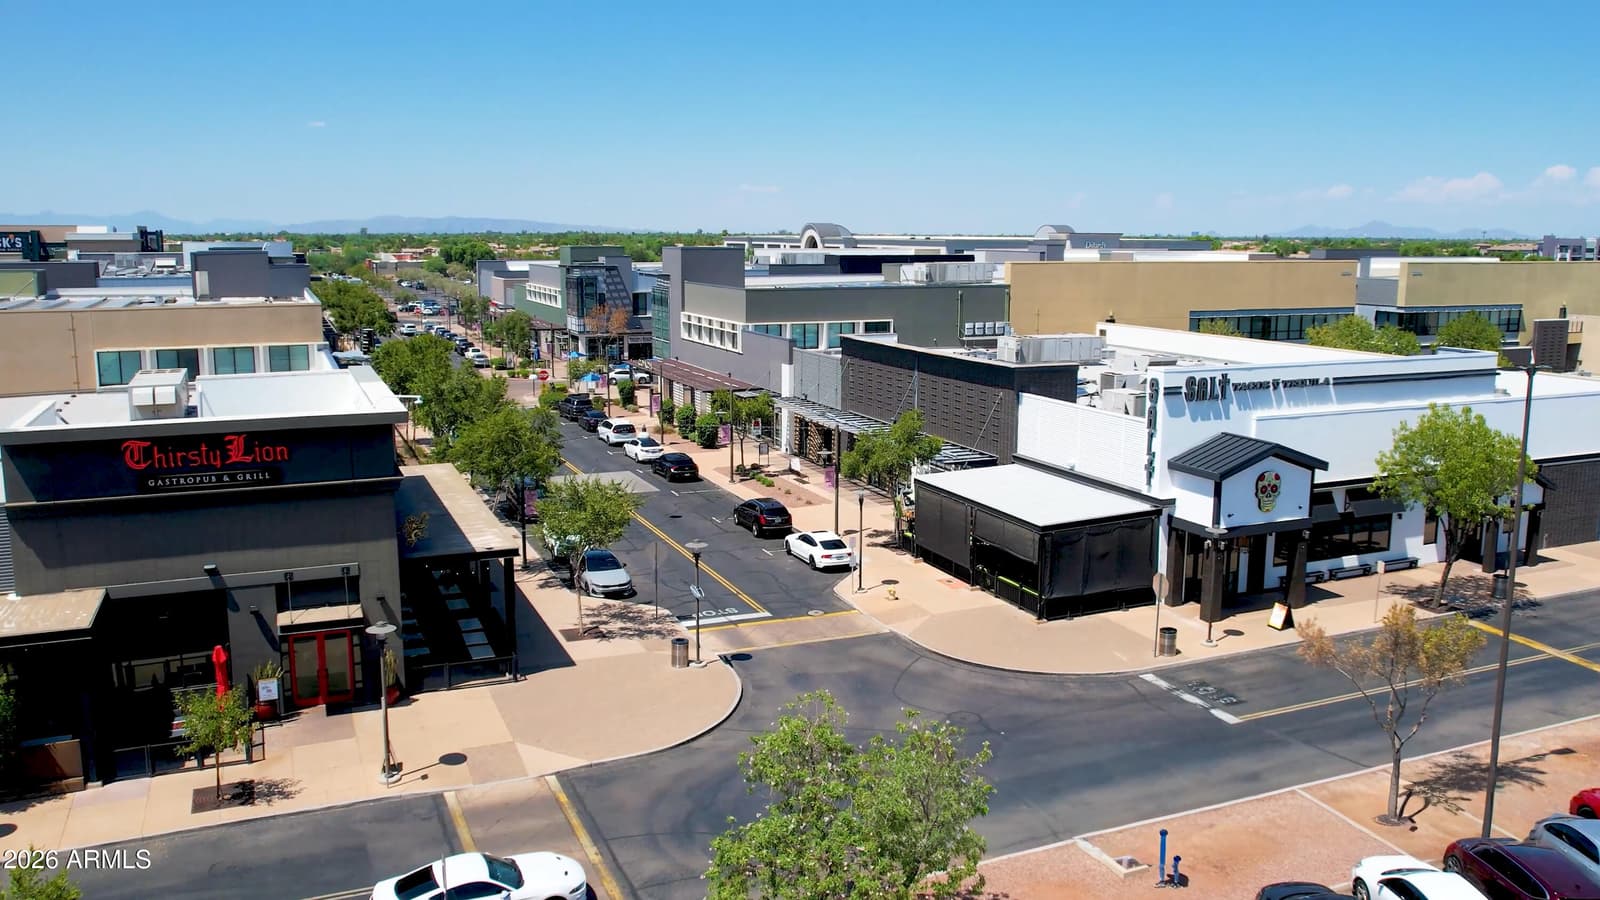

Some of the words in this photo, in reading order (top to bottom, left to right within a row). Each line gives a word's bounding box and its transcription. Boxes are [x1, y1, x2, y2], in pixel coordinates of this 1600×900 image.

[0, 234, 22, 248] K'S
[1184, 373, 1230, 402] SALT
[121, 440, 221, 470] Thirsty
[224, 434, 289, 464] Lion
[148, 475, 217, 487] GASTROPUB
[223, 474, 230, 482] &
[237, 471, 270, 481] GRILL
